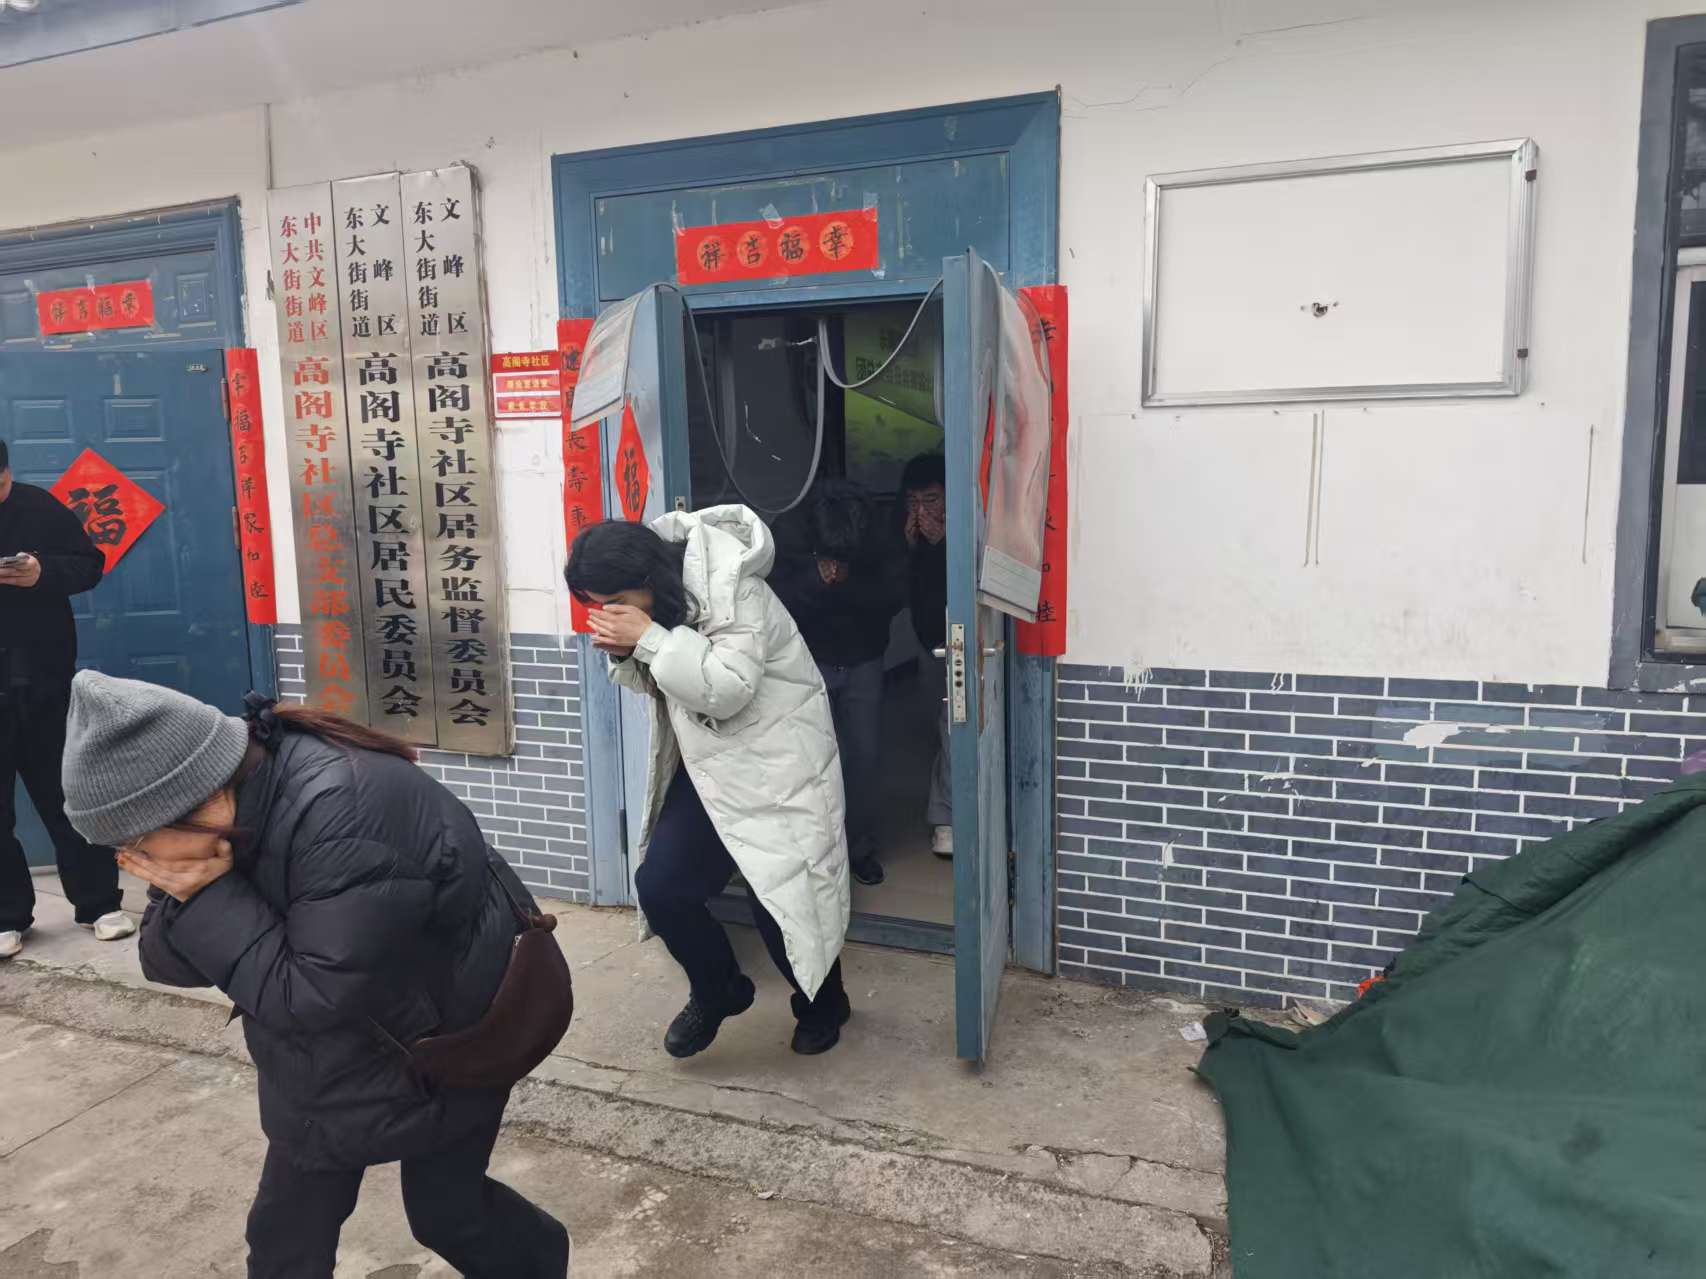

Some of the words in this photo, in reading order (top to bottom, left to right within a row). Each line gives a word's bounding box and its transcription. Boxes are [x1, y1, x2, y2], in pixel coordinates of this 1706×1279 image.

[280, 215, 305, 343] 东大街街道
[303, 211, 328, 341] 中共文峰区
[344, 206, 372, 338] 东大街街道
[370, 203, 399, 337] 文峰区
[413, 200, 441, 337] 东大街街道
[440, 197, 469, 335] 文峰区
[67, 483, 128, 546] 福
[355, 352, 423, 717] 高阁寺社区居民委员会
[426, 351, 492, 727] 高阁寺社区居务监督委员会
